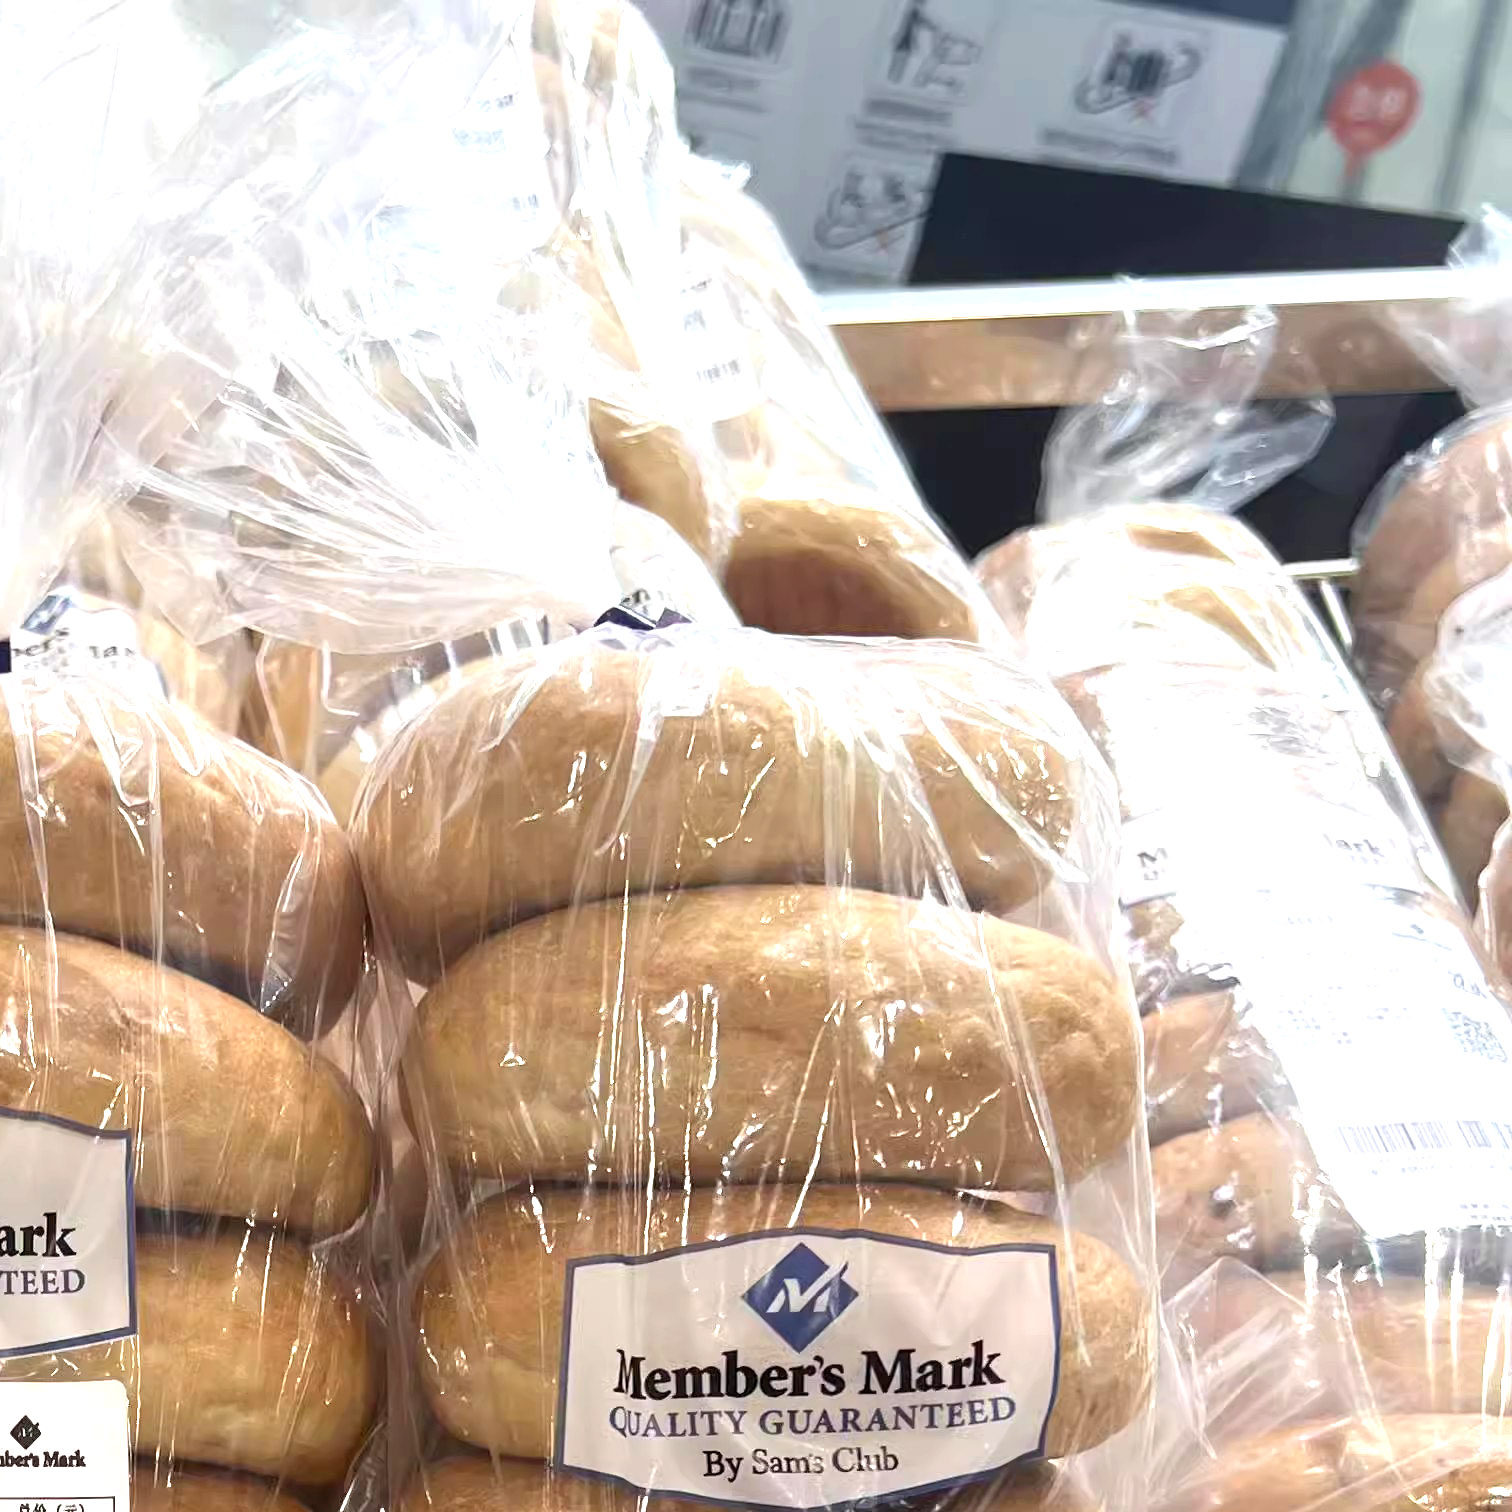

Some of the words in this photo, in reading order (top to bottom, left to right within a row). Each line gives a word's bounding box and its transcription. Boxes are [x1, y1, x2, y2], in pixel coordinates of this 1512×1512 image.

[613, 1349, 845, 1400] Member's
[861, 1340, 1006, 1395] Mark
[609, 1406, 747, 1438] QUALITY
[759, 1395, 1017, 1436] GUARANTEED
[44, 1451, 86, 1468] Mark
[703, 1450, 744, 1482] By
[831, 1446, 899, 1472] Club
